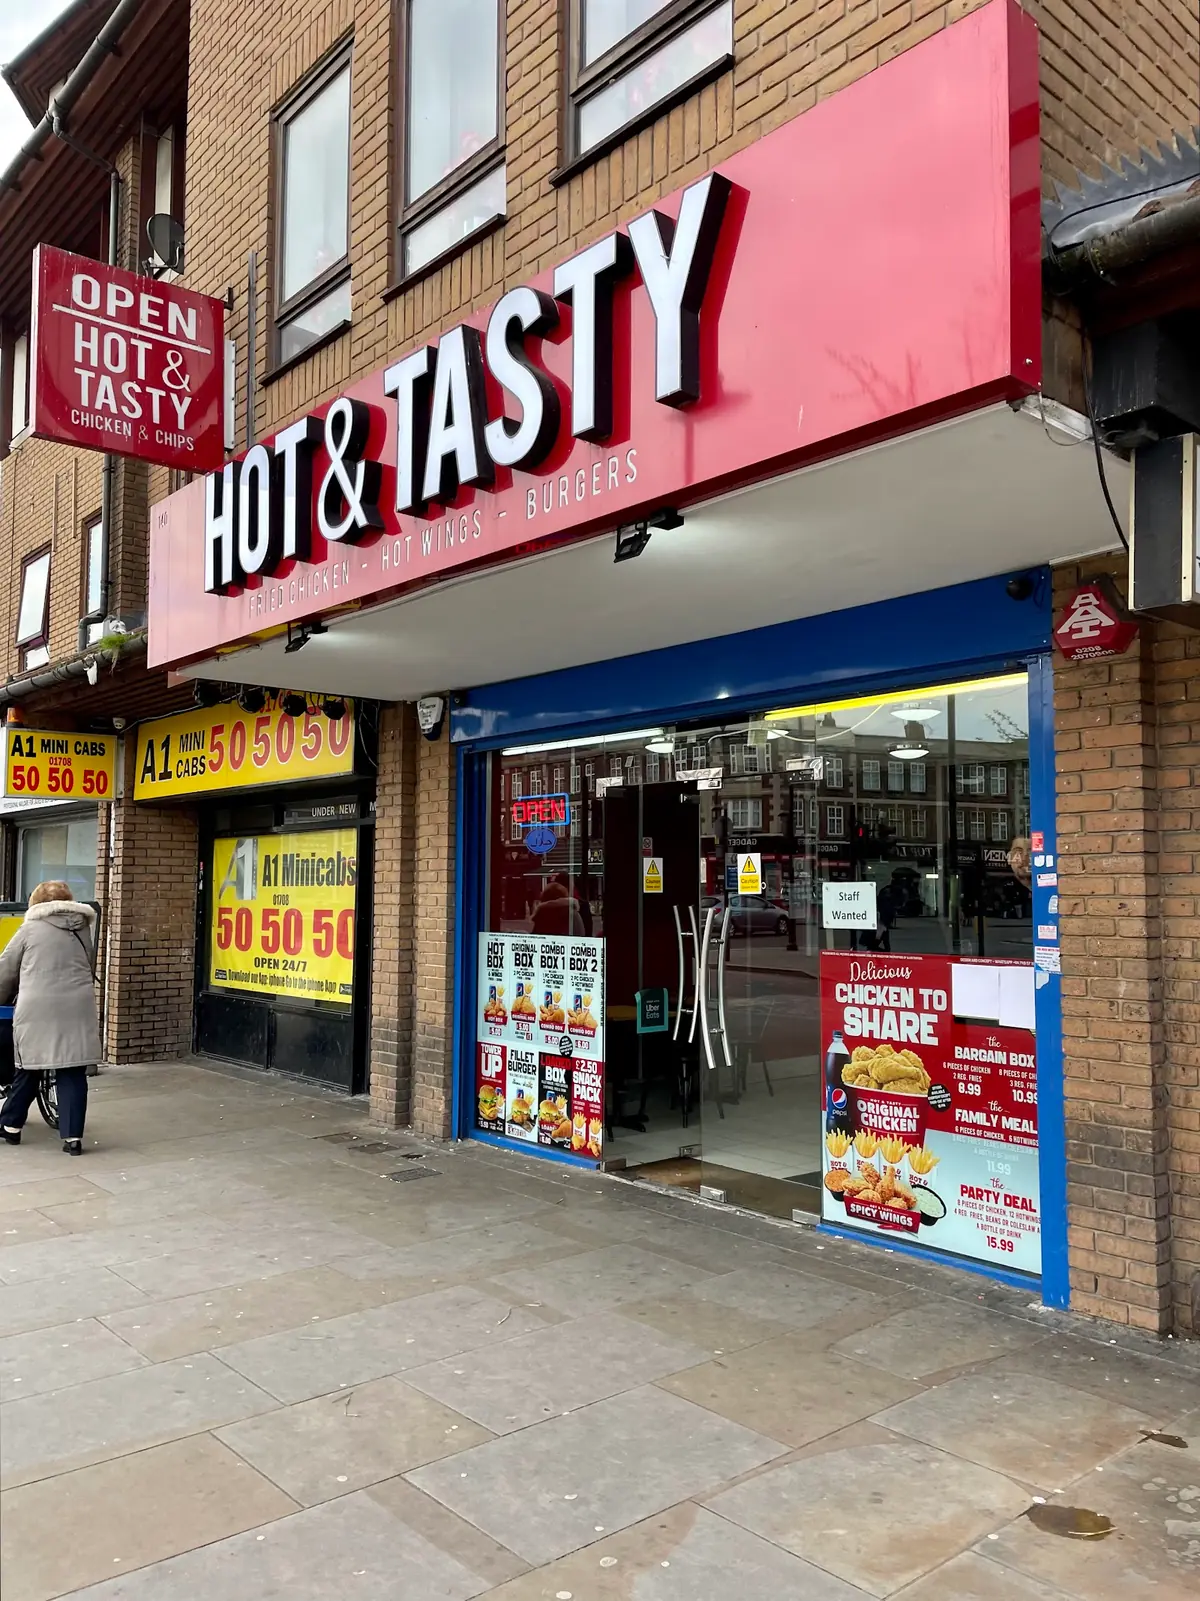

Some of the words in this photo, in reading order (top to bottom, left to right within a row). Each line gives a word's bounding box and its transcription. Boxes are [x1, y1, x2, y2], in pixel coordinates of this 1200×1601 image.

[71, 273, 198, 341] OPEN
[74, 321, 153, 380] HOT
[161, 350, 192, 393] &
[204, 415, 308, 593] HOT
[317, 396, 369, 541] &
[383, 171, 714, 513] TASTY
[74, 368, 193, 431] TASTY
[71, 409, 132, 437] CHICKEN
[138, 425, 149, 441] &
[155, 430, 195, 451] CHIPS
[249, 584, 284, 620] FRIED
[289, 559, 350, 605] CHICKEN
[381, 535, 412, 571] HOT
[421, 508, 481, 557] WINGS
[526, 448, 639, 520] BURGERS
[1075, 645, 1102, 654] 0208
[179, 730, 206, 753] MINI
[208, 720, 246, 773] 50
[252, 711, 296, 769] 50
[301, 700, 352, 761] 50
[11, 735, 37, 758] A1
[41, 738, 69, 754] MINI
[74, 741, 106, 756] CABS
[49, 757, 72, 766] 01708
[140, 734, 173, 784] A1
[176, 755, 206, 779] CABS
[12, 765, 40, 791] 50
[47, 767, 74, 793] 50
[82, 769, 108, 795] 50
[311, 806, 335, 817] UNDER
[339, 803, 357, 815] NEW
[513, 799, 565, 823] OPEN
[262, 854, 279, 887] A1
[281, 850, 356, 888] Minicabs
[272, 894, 290, 906] 01708
[838, 891, 860, 901] Staff
[831, 910, 867, 921] Wanted
[216, 907, 253, 952] 50
[261, 908, 303, 956] 50
[313, 909, 355, 960] 50
[487, 941, 505, 955] HOT
[511, 943, 537, 953] ORIGINAL
[540, 944, 565, 955] COMBO
[570, 946, 597, 957] COMBO
[254, 956, 280, 970] OPEN
[282, 959, 308, 972] 24/7
[486, 954, 504, 969] BOX
[514, 952, 534, 968] BOX
[540, 955, 558, 970] BOX
[561, 956, 565, 970] 1
[569, 957, 588, 972] BOX
[591, 958, 598, 972] 2
[850, 960, 913, 982] Delicious
[325, 979, 337, 993] App
[835, 983, 915, 1008] CHICKEN
[918, 988, 947, 1011] TO
[843, 1006, 939, 1046] SHARE
[480, 1043, 502, 1056] TOWER
[986, 1035, 1001, 1047] the
[510, 1049, 535, 1064] FILLET
[954, 1045, 1007, 1065] BARGAIN
[1009, 1052, 1036, 1068] BOX
[480, 1052, 503, 1079] UP
[507, 1060, 537, 1076] BURGER
[575, 1059, 598, 1074] £2.50
[943, 1061, 947, 1069] 6
[947, 1062, 963, 1071] PIECES
[970, 1064, 991, 1074] CHICKEN
[998, 1068, 1002, 1076] 8
[1003, 1069, 1020, 1078] PIECES
[1020, 1071, 1028, 1079] OF
[545, 1065, 566, 1084] BOX
[572, 1071, 602, 1088] SNACK
[953, 1072, 957, 1080] 2
[968, 1074, 982, 1083] FRIES
[573, 1084, 601, 1104] PACK
[958, 1082, 981, 1096] 8.99
[832, 1109, 848, 1117] pepsi
[857, 1099, 920, 1119] ORIGINAL
[988, 1100, 1004, 1112] the
[860, 1112, 917, 1132] CHICKEN
[955, 1108, 998, 1128] FAMILY
[1001, 1115, 1038, 1135] MEAL
[955, 1125, 959, 1133] 6
[959, 1126, 976, 1135] PIECES
[986, 1159, 1011, 1176] 11.99
[990, 1177, 1005, 1190] the
[960, 1184, 1000, 1205] PARTY
[1003, 1193, 1037, 1213] DEAL
[850, 1203, 878, 1218] SPICY
[879, 1209, 913, 1227] WINGS
[961, 1199, 978, 1209] PIECES
[978, 1203, 985, 1211] OF
[1009, 1210, 1015, 1218] 12
[1015, 1212, 1041, 1224] HOTWINGS
[980, 1223, 998, 1234] BOTTLE
[1006, 1230, 1022, 1239] DRINK
[985, 1215, 1001, 1225] BEANS
[1001, 1218, 1009, 1226] OR
[1009, 1219, 1035, 1233] COLESLAW
[986, 1235, 1014, 1253] 15.99
